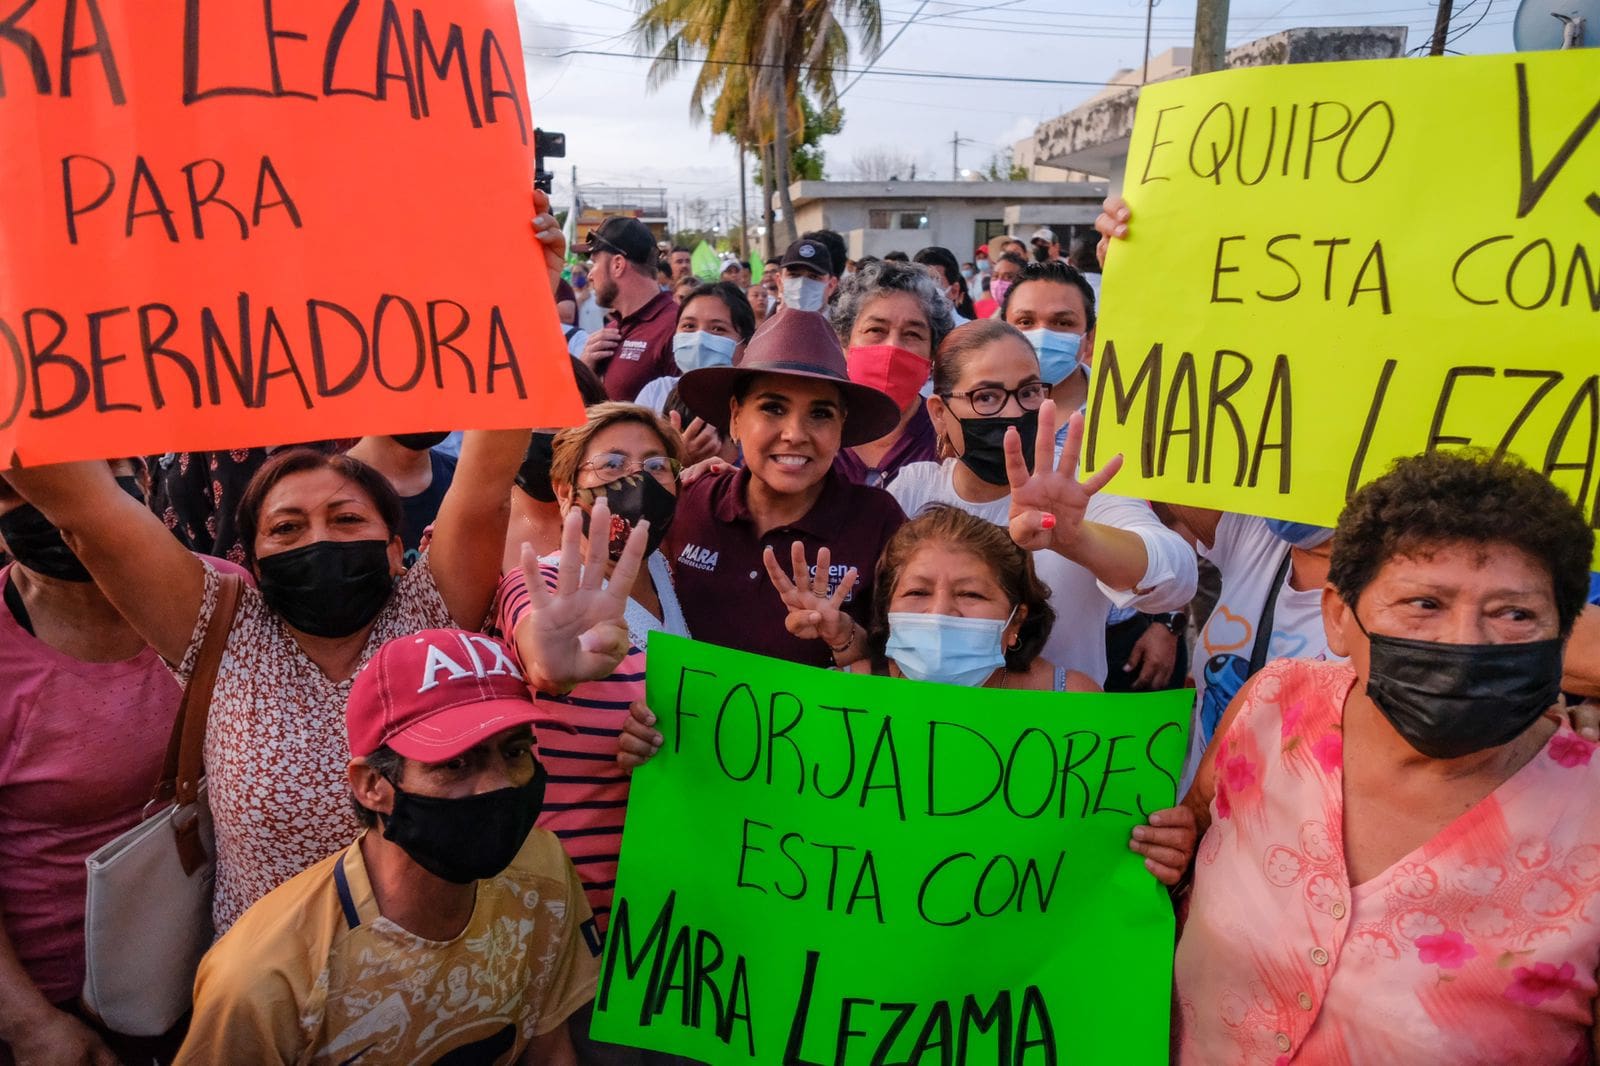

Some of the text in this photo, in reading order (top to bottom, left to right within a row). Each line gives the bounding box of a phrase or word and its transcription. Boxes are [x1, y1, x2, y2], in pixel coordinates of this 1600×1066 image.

[183, 0, 527, 146] LEZAMA
[1139, 62, 1600, 219] EQUIPO V
[62, 155, 302, 245] PARA
[1210, 234, 1600, 315] ESTA CON
[1085, 340, 1600, 531] MARA LEZA
[681, 543, 719, 567] MARA
[674, 666, 1182, 824] FORJADORES
[736, 818, 1066, 927] ESTA CON
[597, 889, 1059, 1066] MARA LEZAMA
